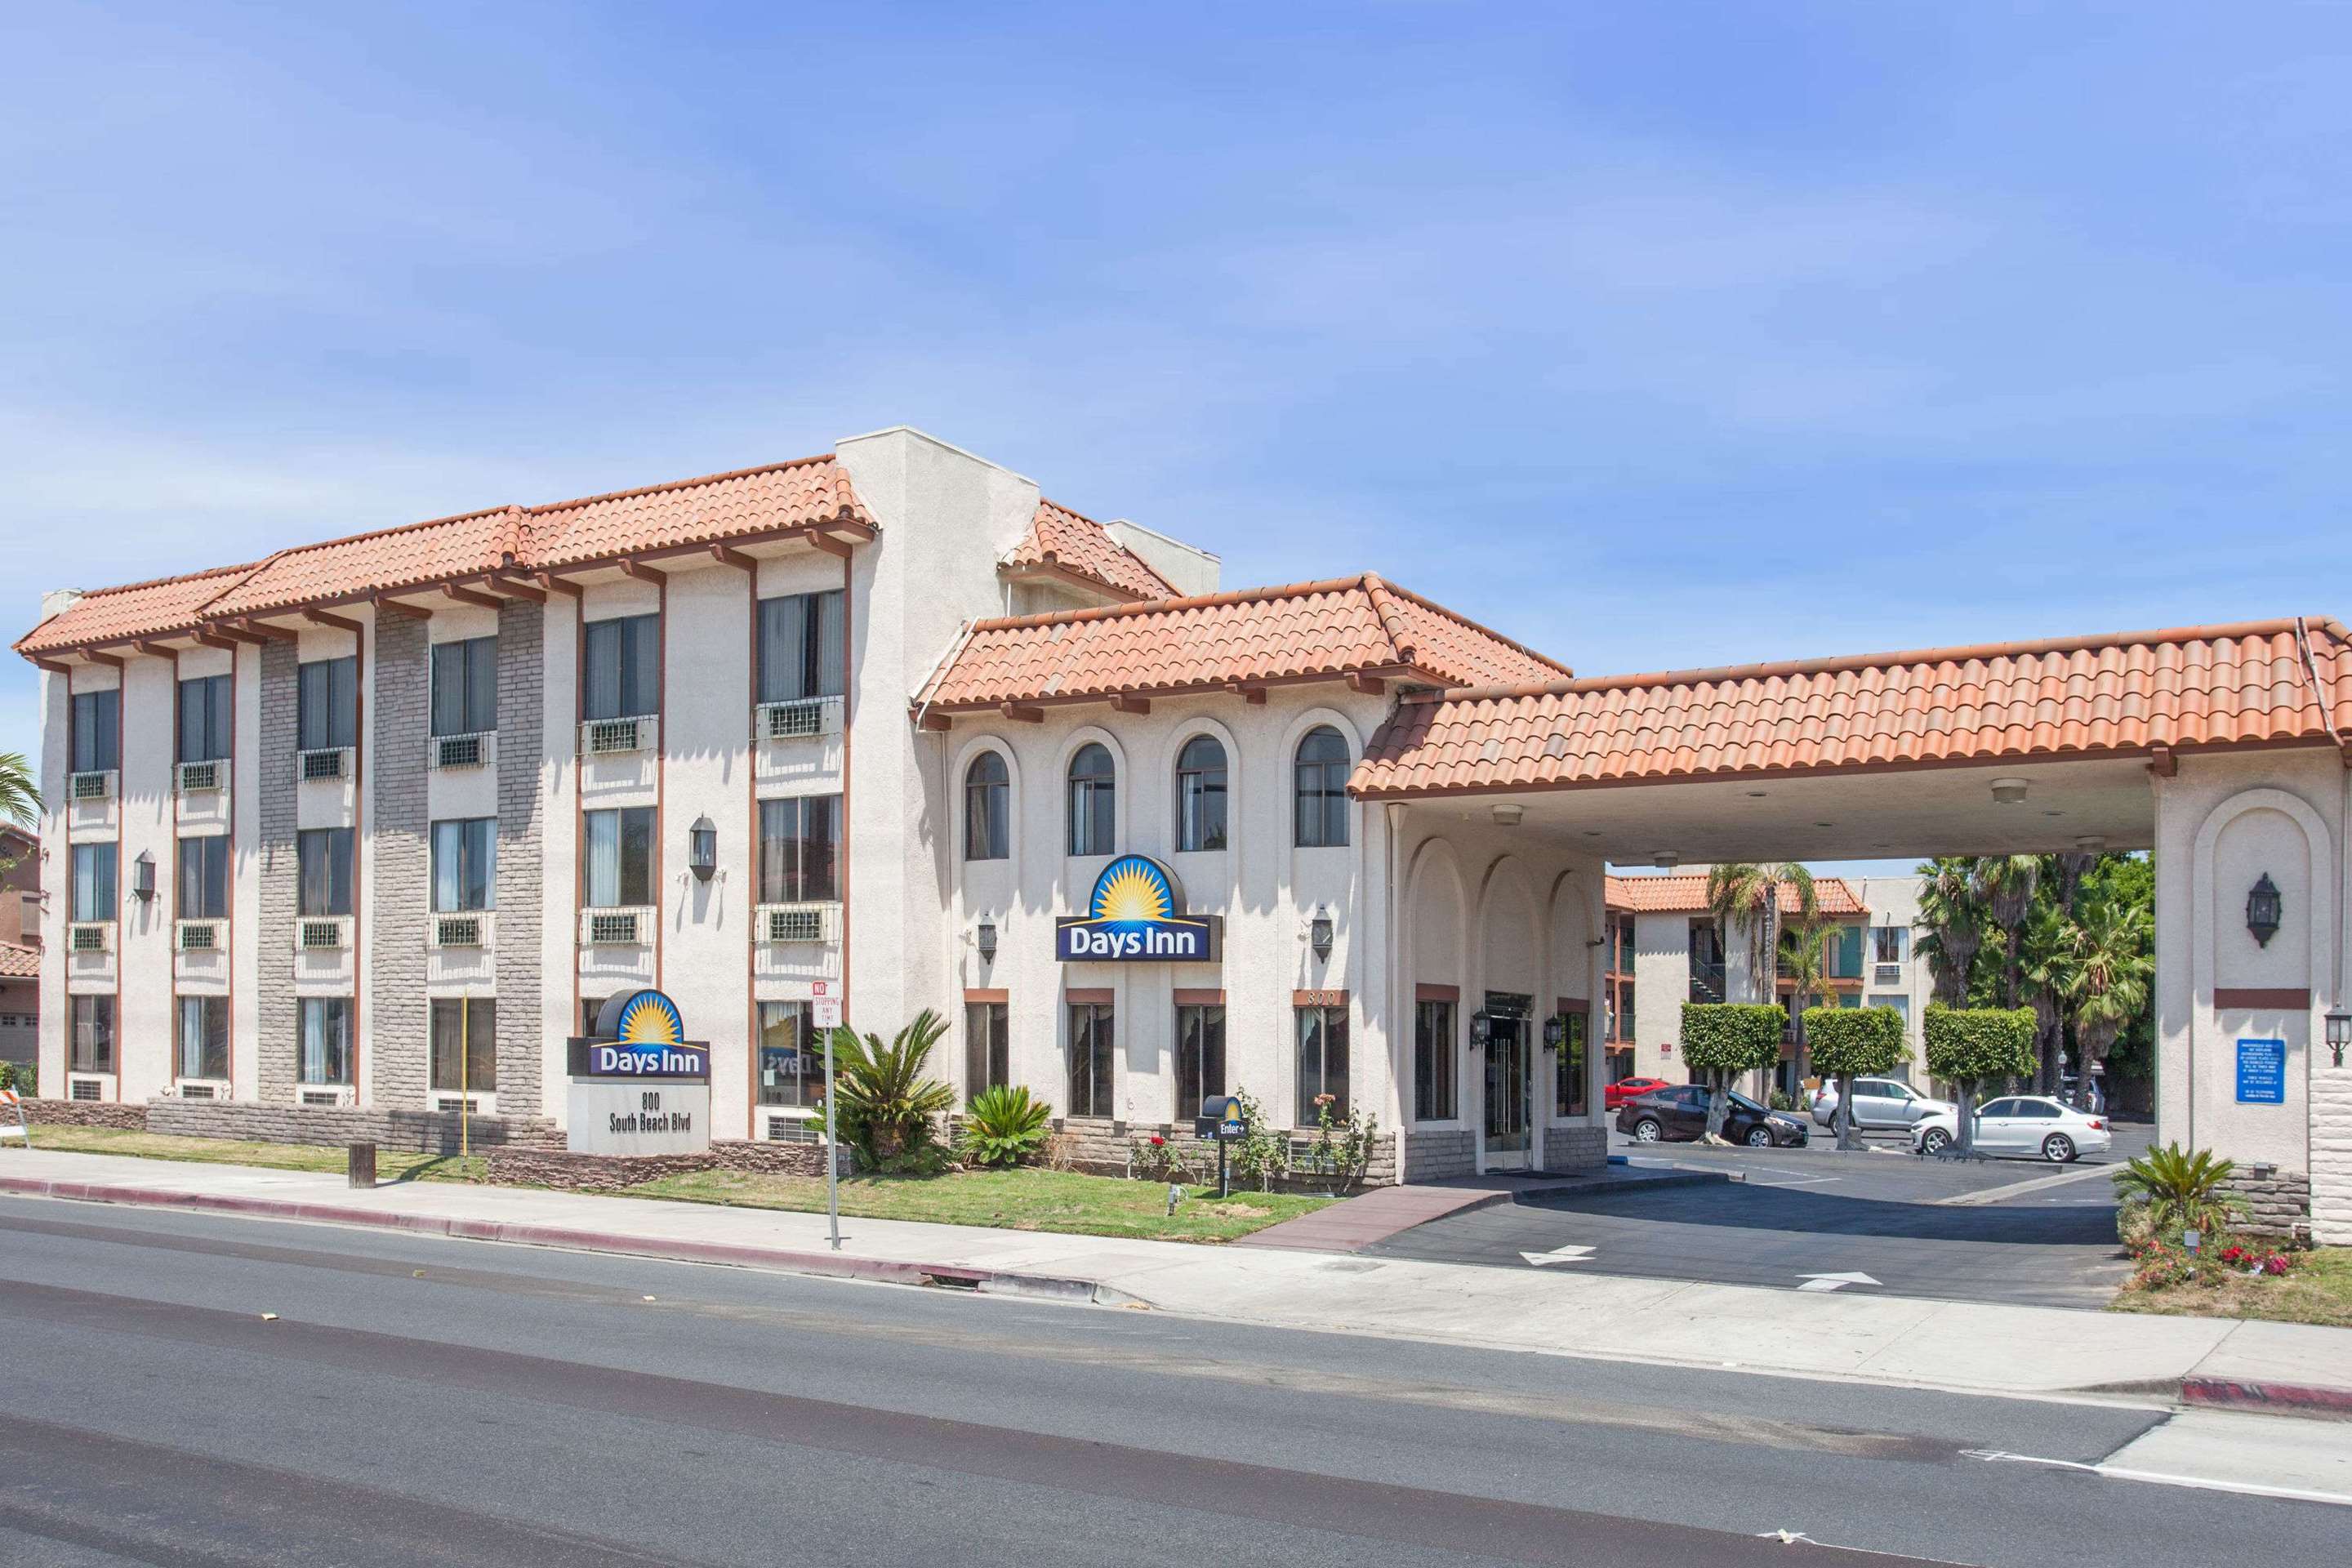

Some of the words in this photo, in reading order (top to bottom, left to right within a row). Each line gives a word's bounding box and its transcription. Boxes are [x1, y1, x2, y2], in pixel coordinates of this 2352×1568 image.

[1071, 928, 1141, 958] Days
[1147, 928, 1195, 954] Inn
[814, 983, 825, 994] NO
[815, 997, 839, 1005] STOPPING
[1307, 992, 1334, 1005] 800
[601, 1048, 658, 1074] Days
[662, 1049, 699, 1072] Inn
[642, 1092, 660, 1111] 800
[609, 1113, 637, 1132] South
[640, 1113, 668, 1131] Beach
[672, 1112, 691, 1131] Blvd
[1220, 1124, 1239, 1134] Enter
